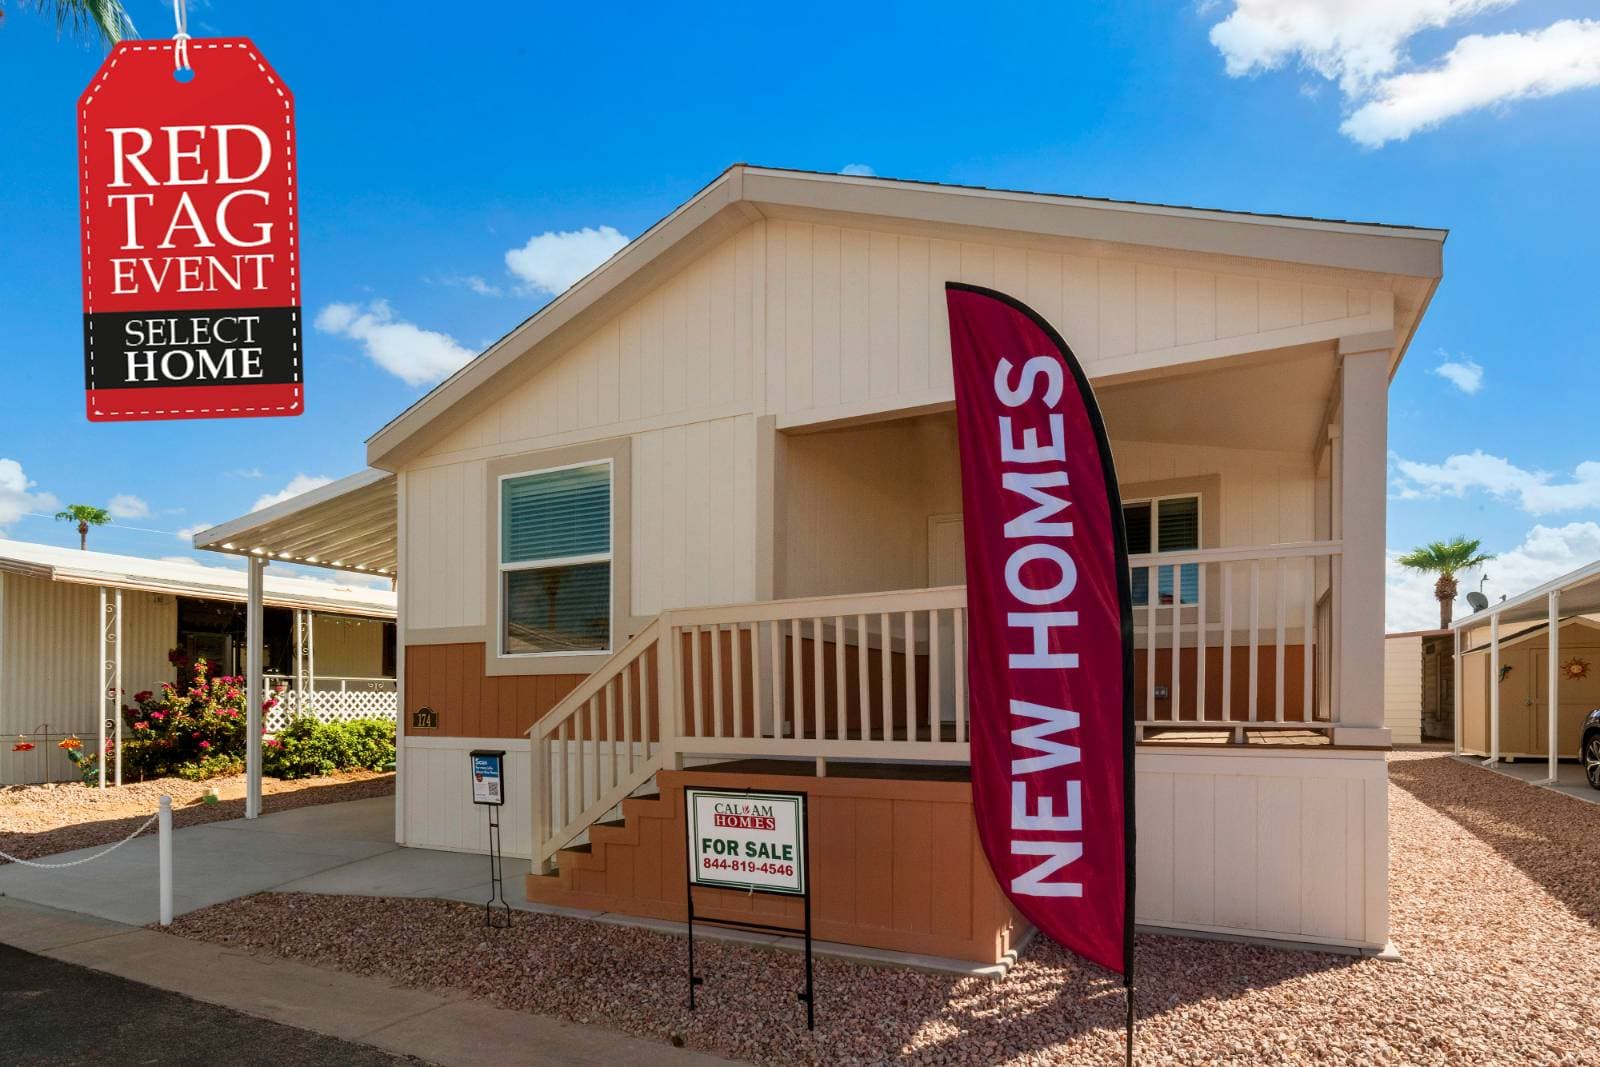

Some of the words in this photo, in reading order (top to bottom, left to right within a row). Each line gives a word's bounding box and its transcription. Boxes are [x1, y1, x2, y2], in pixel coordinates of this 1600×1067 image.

[993, 355, 1080, 669] HOMES
[418, 713, 431, 727] 174
[1009, 699, 1084, 898] NEW
[716, 815, 775, 830] HOMES
[702, 838, 740, 857] FOR
[745, 841, 794, 861] SALE
[703, 857, 794, 877] 844-819-4546
